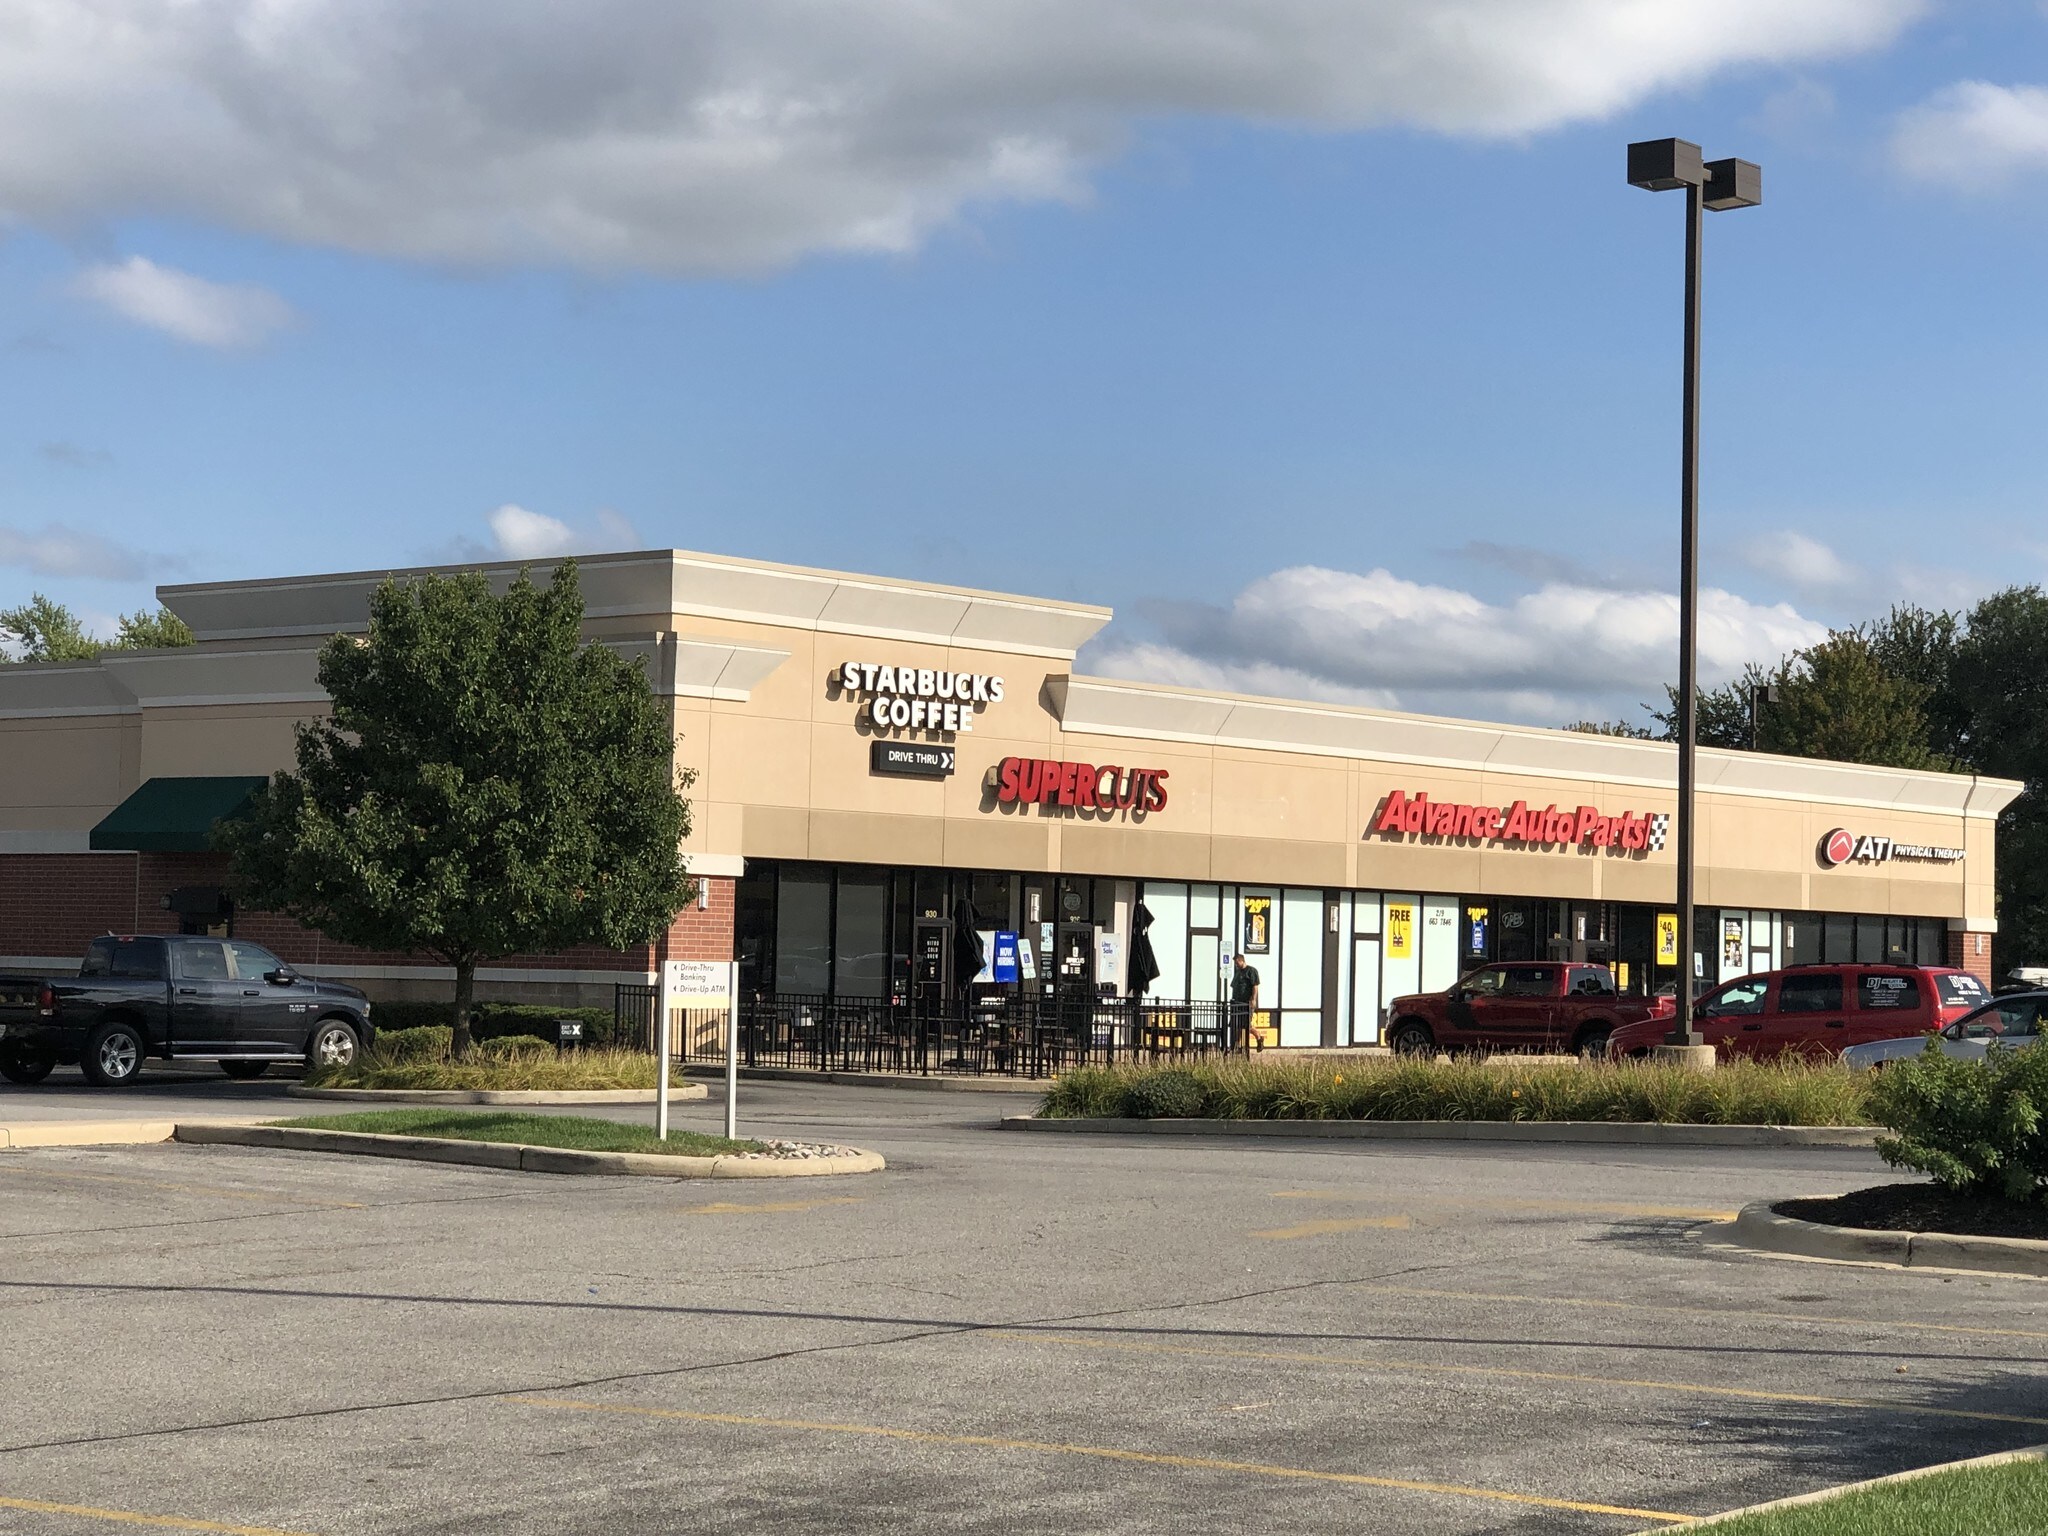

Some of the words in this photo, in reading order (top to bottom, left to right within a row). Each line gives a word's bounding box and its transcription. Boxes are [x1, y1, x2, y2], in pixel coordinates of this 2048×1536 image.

[844, 662, 1005, 702] STARBUCKS
[873, 698, 973, 731] COFFEE
[888, 751, 914, 764] DRIVE
[916, 752, 938, 765] THRU
[999, 757, 1169, 812] SUPERCUTS
[1378, 790, 1501, 838] Advance
[1502, 800, 1574, 843] Auto
[1572, 806, 1650, 849] Parts
[1857, 836, 1893, 861] ATI
[1895, 845, 1933, 858] PHYSICAL
[1934, 848, 1967, 862] THERAPY
[925, 910, 938, 918] 930
[1390, 909, 1411, 922] FREE
[999, 947, 1013, 957] NOW
[680, 963, 714, 972] Drive-Thru
[997, 956, 1015, 966] HIRING
[680, 973, 706, 982] Banking
[680, 985, 709, 994] Drive-Up
[710, 985, 726, 993] ATM
